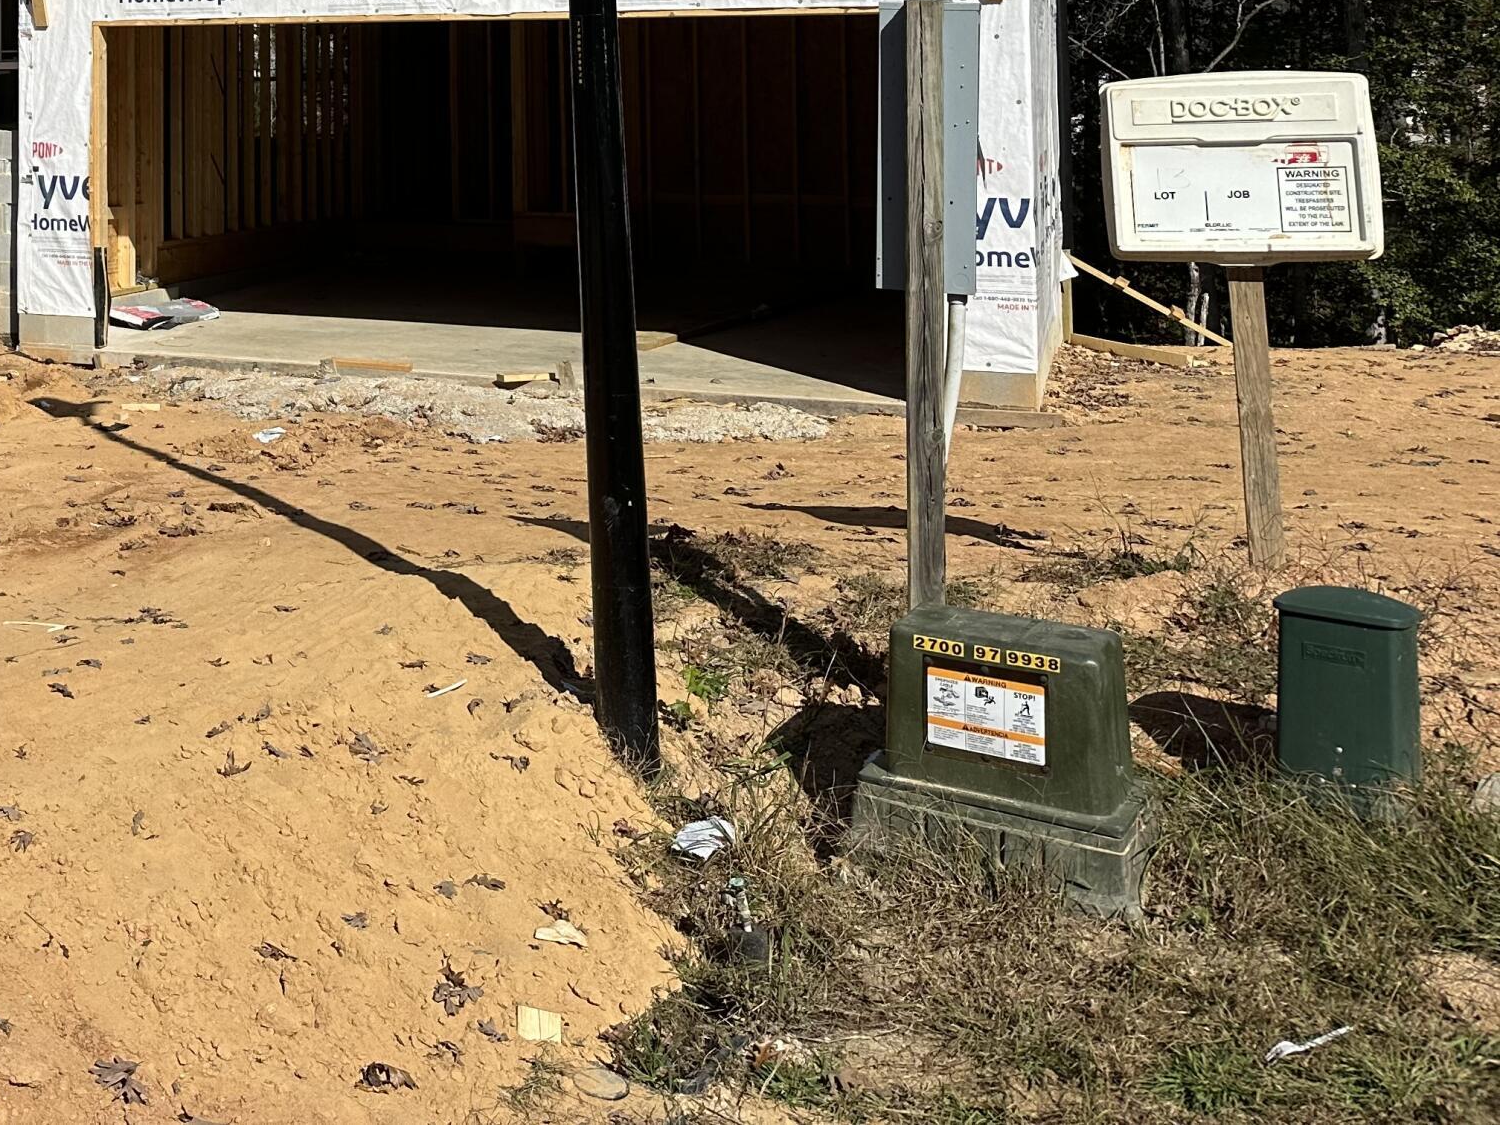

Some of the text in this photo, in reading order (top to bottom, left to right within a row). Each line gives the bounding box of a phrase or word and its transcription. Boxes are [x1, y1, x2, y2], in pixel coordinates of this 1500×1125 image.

[1284, 169, 1340, 178] WARNING
[1154, 191, 1176, 200] LOT
[1227, 190, 1250, 199] JOB
[914, 636, 1060, 672] 2700 97 9938
[971, 676, 1007, 689] WARNING
[1013, 692, 1036, 701] STOP!
